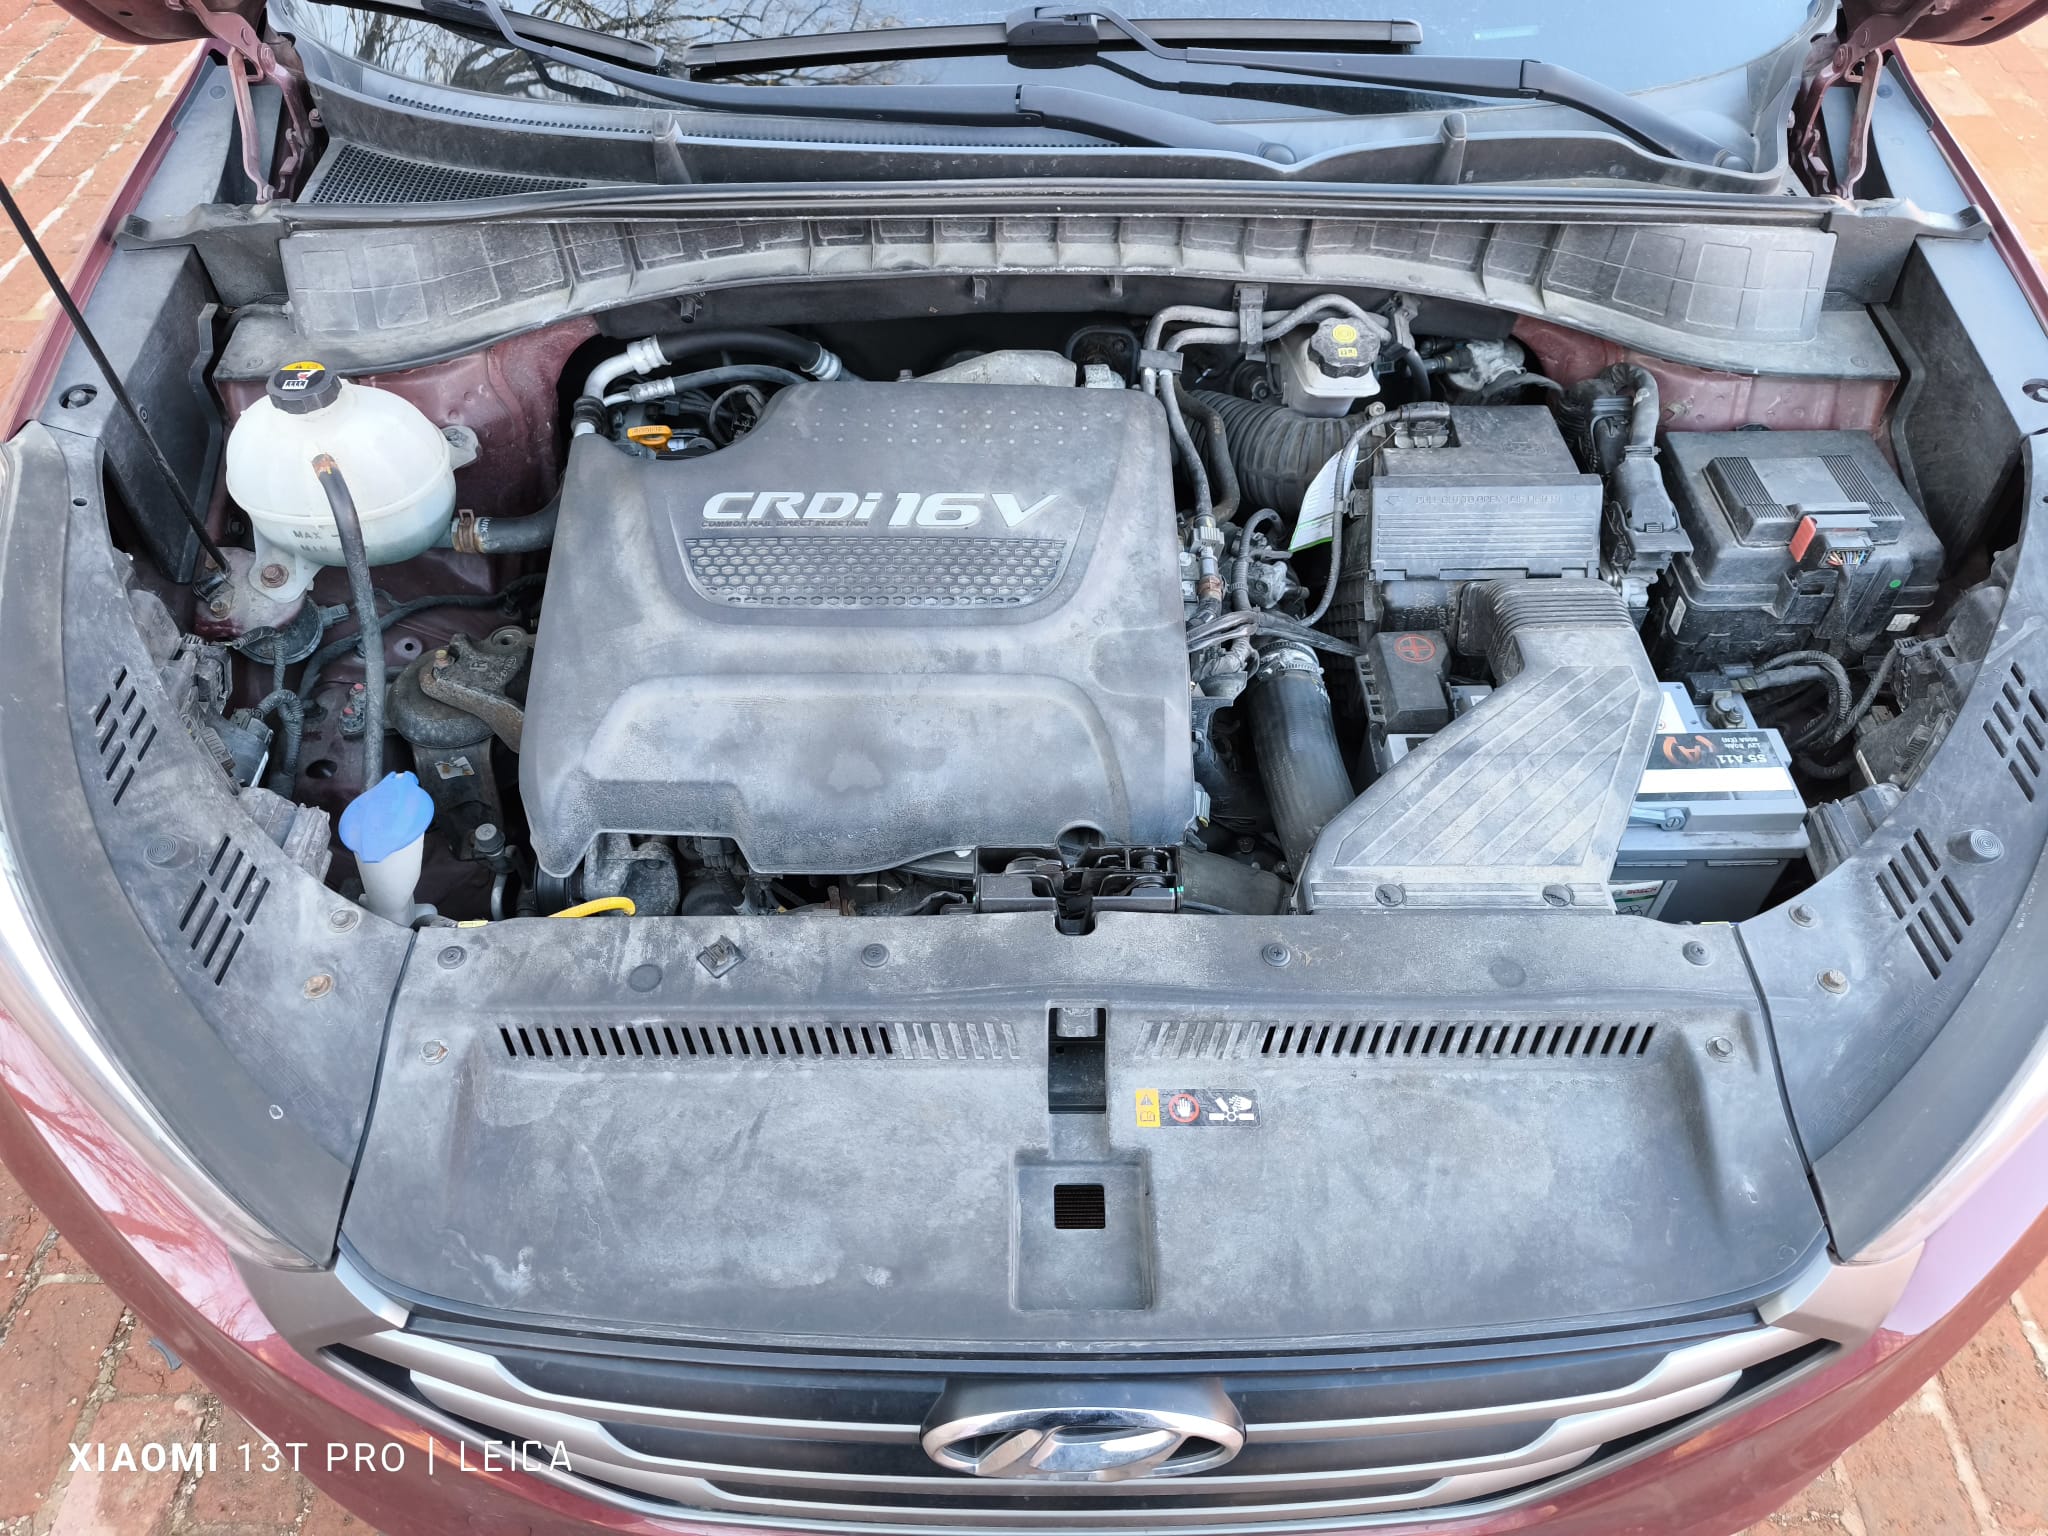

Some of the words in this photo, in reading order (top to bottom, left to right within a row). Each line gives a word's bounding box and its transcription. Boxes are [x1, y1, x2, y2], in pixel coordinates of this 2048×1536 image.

[702, 491, 883, 519] CRDi
[701, 520, 747, 528] COMMON
[776, 519, 813, 527] DIRECT
[815, 520, 869, 528] INJECTION
[292, 530, 321, 539] MAX
[1716, 754, 1743, 764] A11
[1750, 753, 1767, 764] S5
